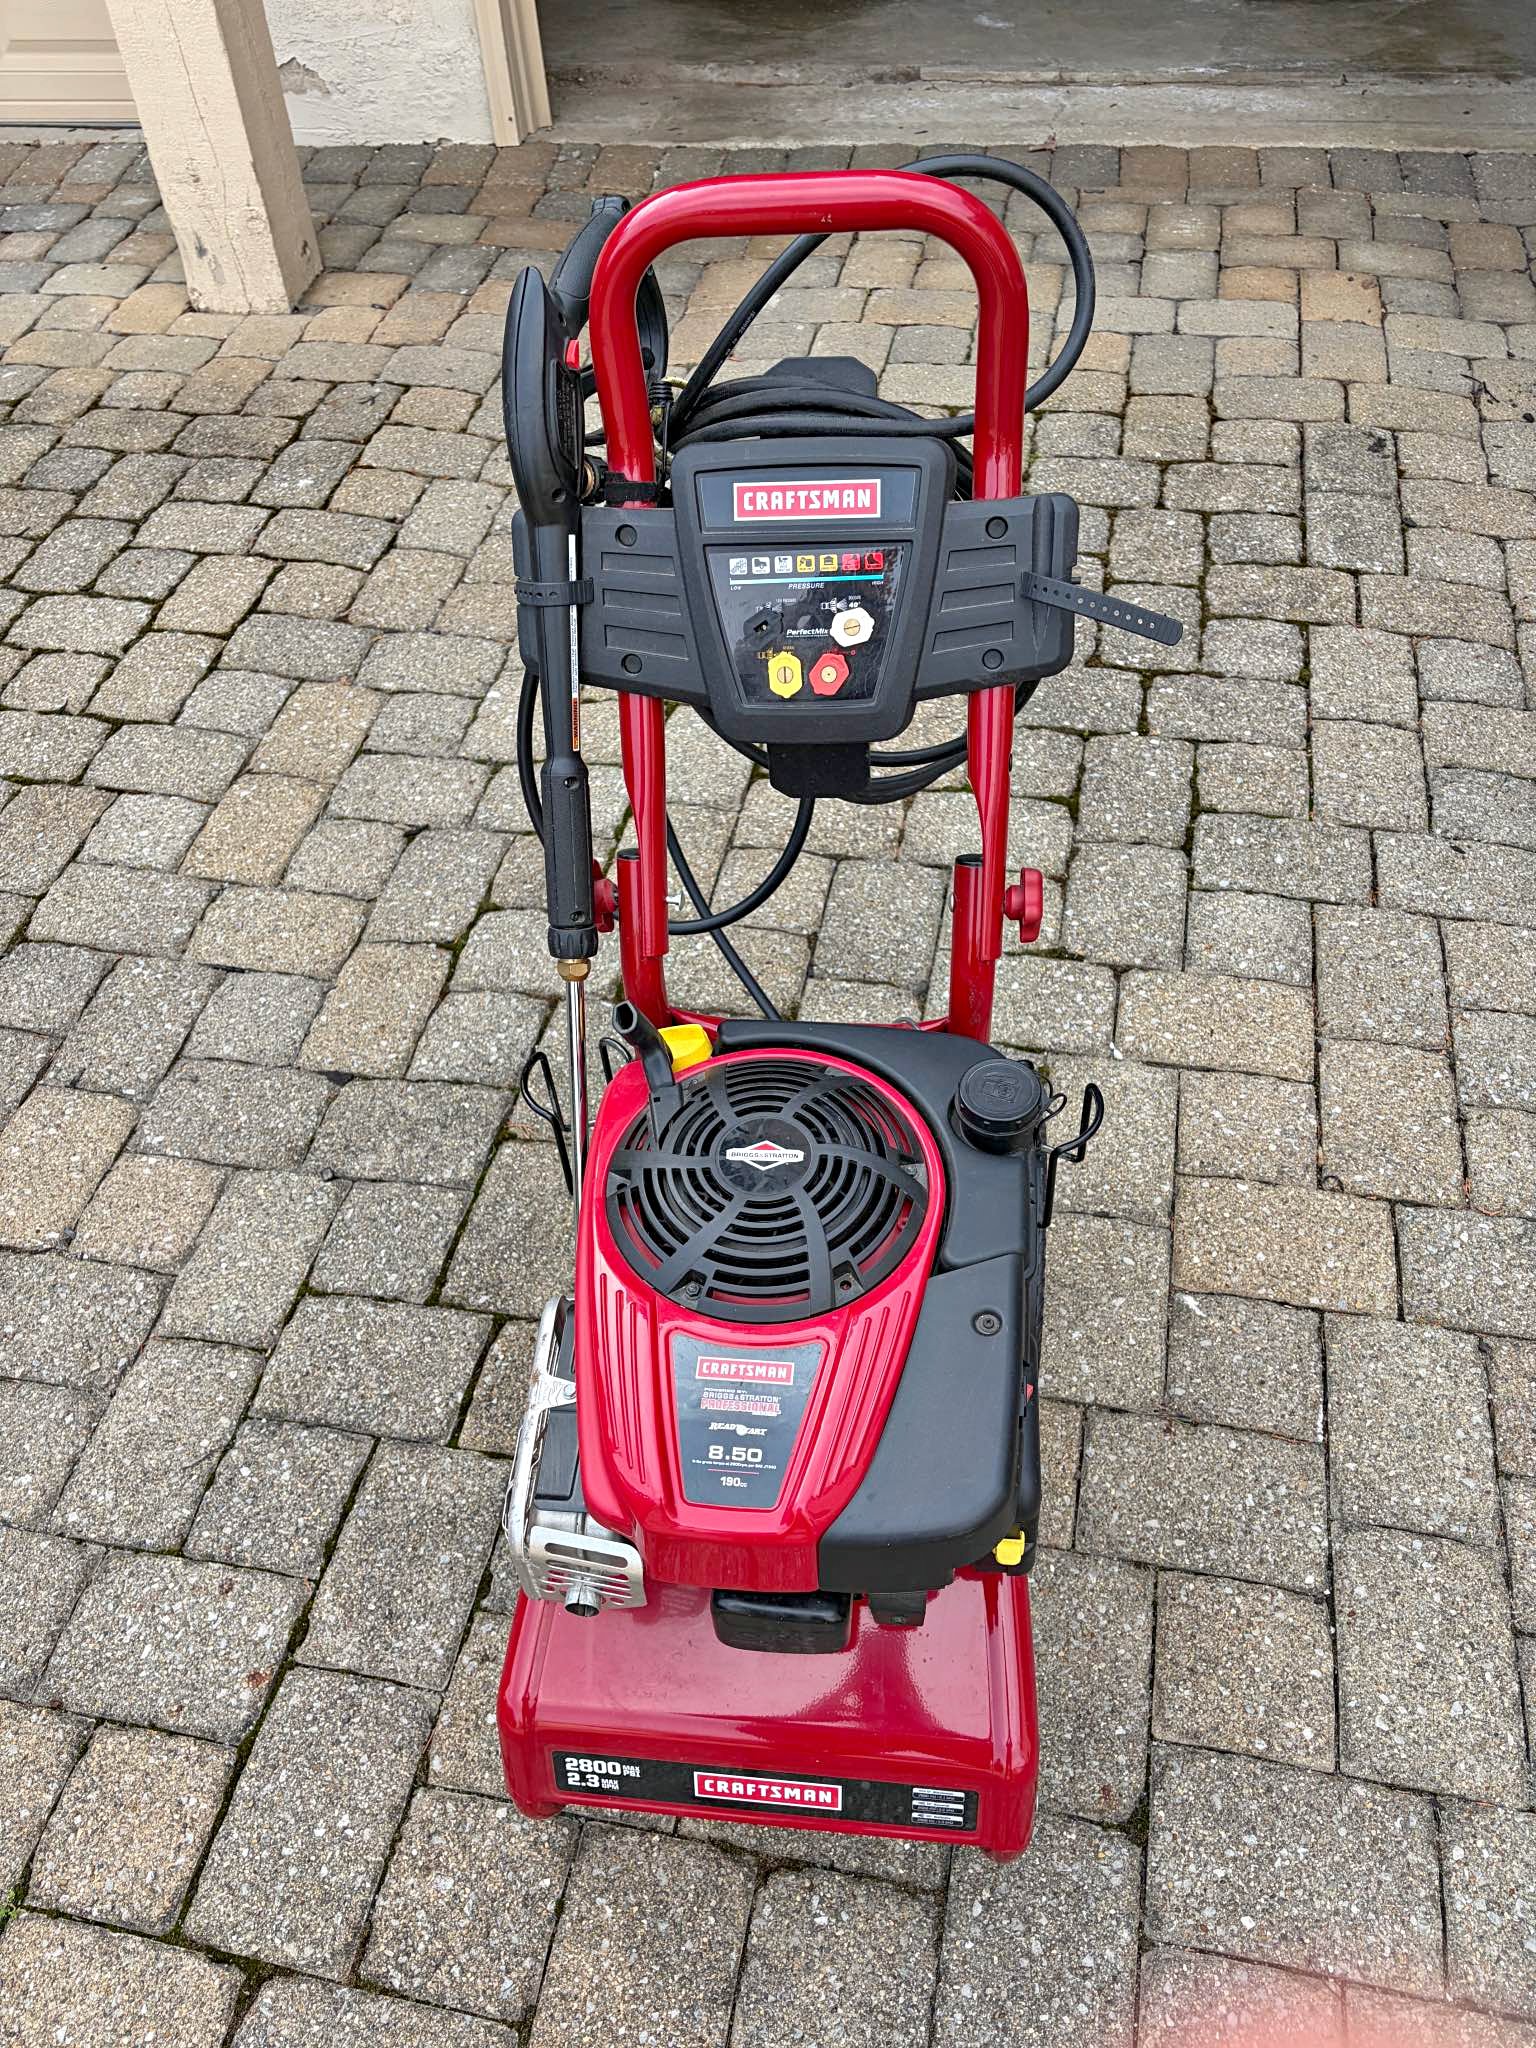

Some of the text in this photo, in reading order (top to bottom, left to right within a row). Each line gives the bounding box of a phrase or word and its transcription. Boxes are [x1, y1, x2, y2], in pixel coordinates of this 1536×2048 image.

[743, 488, 871, 511] CRAFTSMAN
[788, 582, 825, 590] PRESSURE
[786, 628, 829, 636] PerfectMix
[702, 1362, 787, 1379] CRAFTSMAN
[700, 1397, 781, 1414] PROFESSIONAL
[708, 1444, 763, 1463] 8.50
[564, 1757, 622, 1776] 2800
[623, 1770, 641, 1778] PSI
[566, 1772, 600, 1788] 2.3
[704, 1779, 832, 1803] CRAFTSMAN
